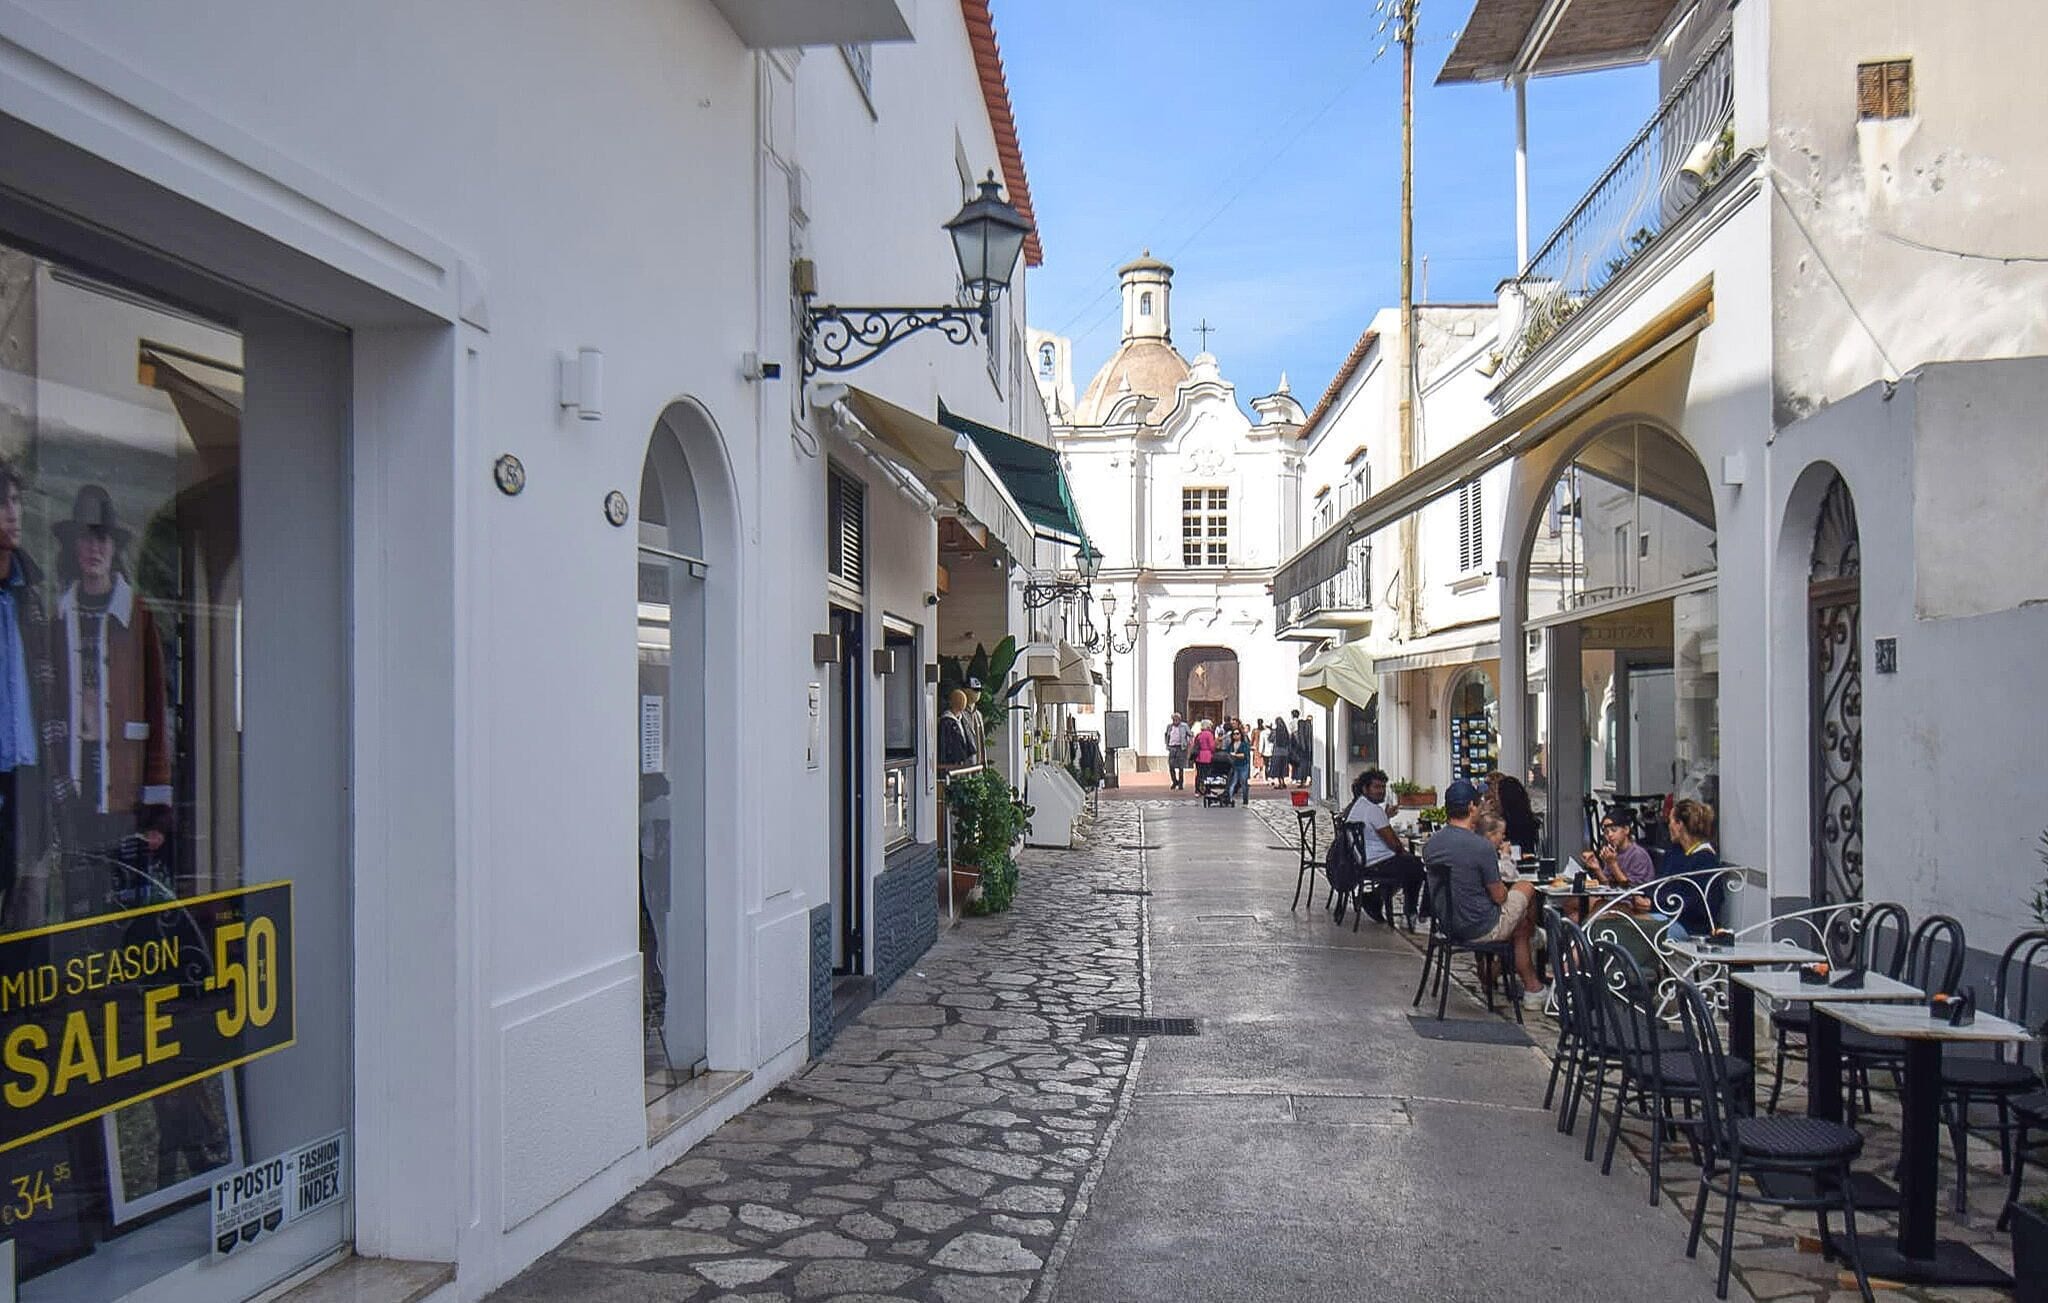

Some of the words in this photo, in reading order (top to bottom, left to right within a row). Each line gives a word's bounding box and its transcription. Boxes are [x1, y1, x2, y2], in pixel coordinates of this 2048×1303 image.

[2, 965, 58, 1012] MID
[66, 935, 179, 994] SEASON
[3, 984, 181, 1108] SALE
[299, 1138, 340, 1174] FASHION
[233, 1158, 283, 1205] POSTO
[299, 1170, 339, 1212] INDEX
